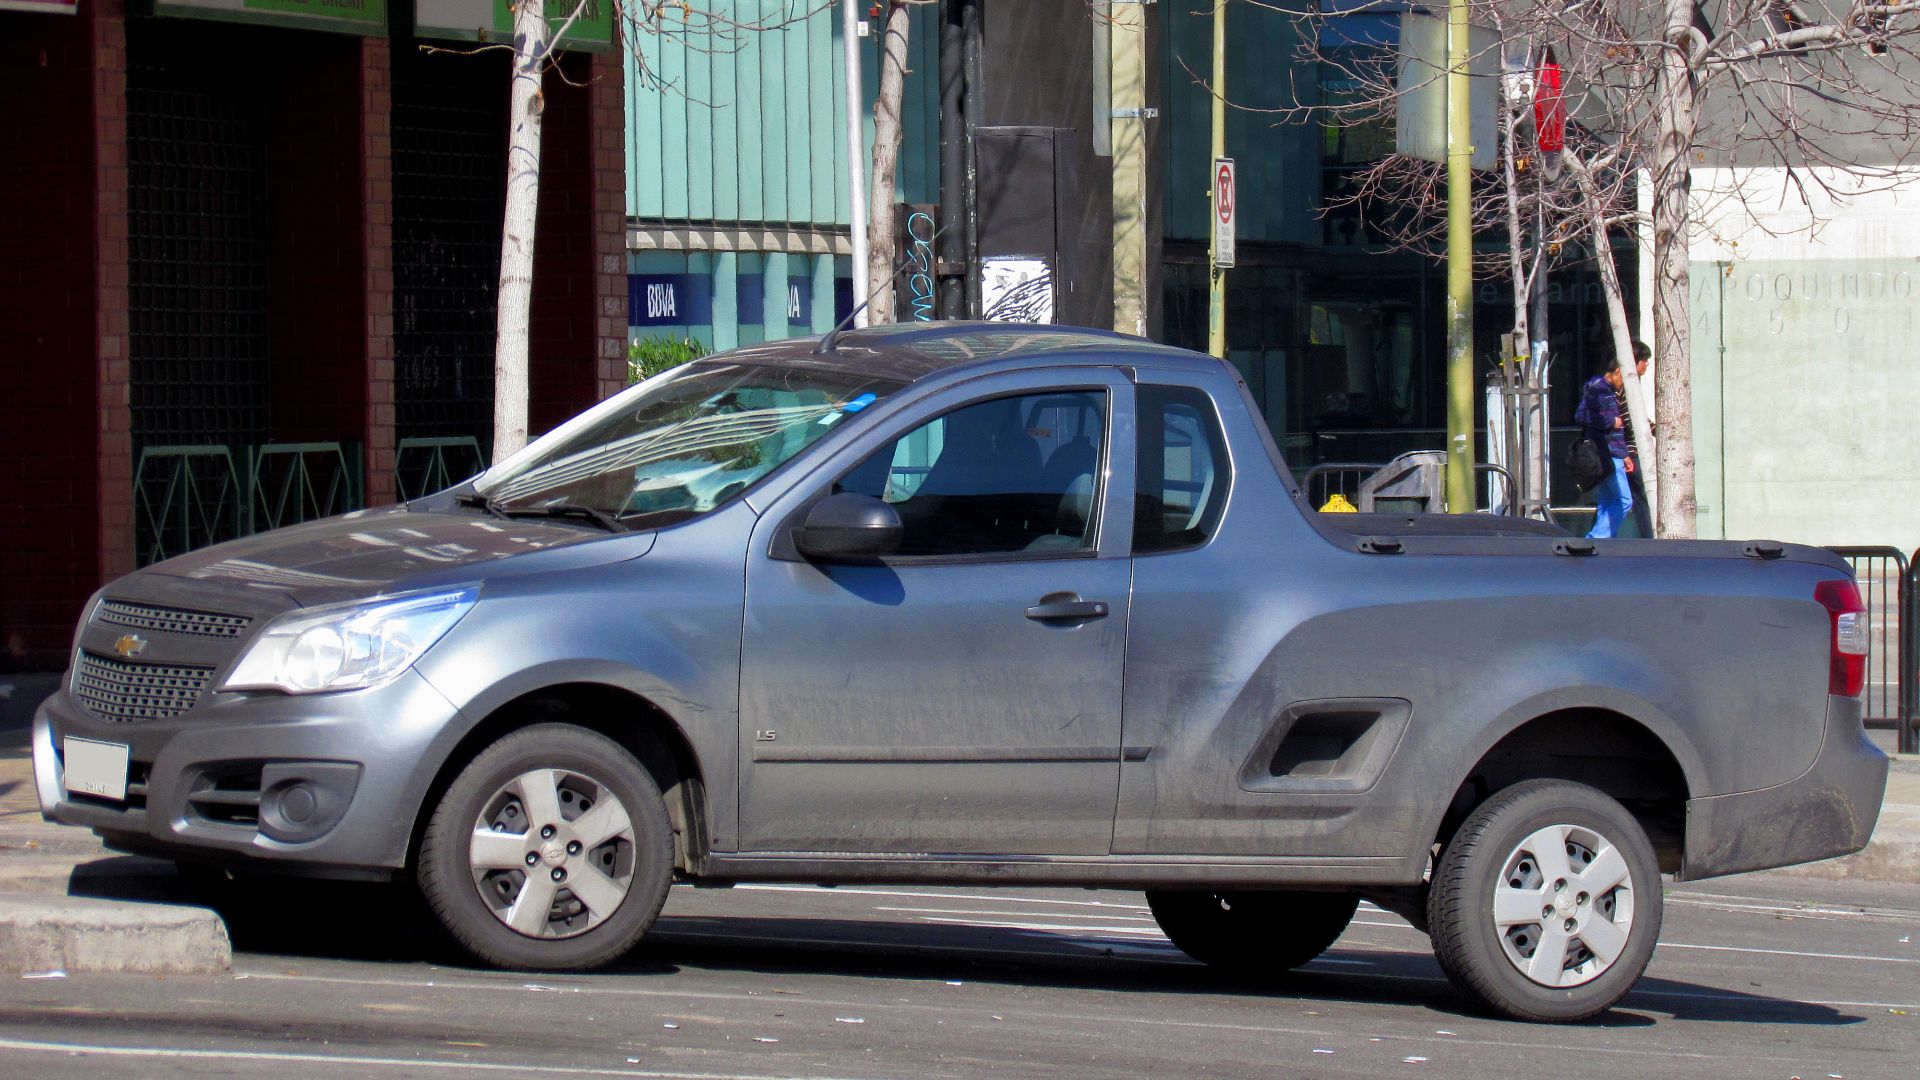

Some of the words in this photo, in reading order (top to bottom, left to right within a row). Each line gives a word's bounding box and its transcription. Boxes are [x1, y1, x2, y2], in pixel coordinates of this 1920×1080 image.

[647, 284, 676, 318] BBVA
[787, 285, 800, 318] VA
[1697, 271, 1911, 301] APOQUINDO
